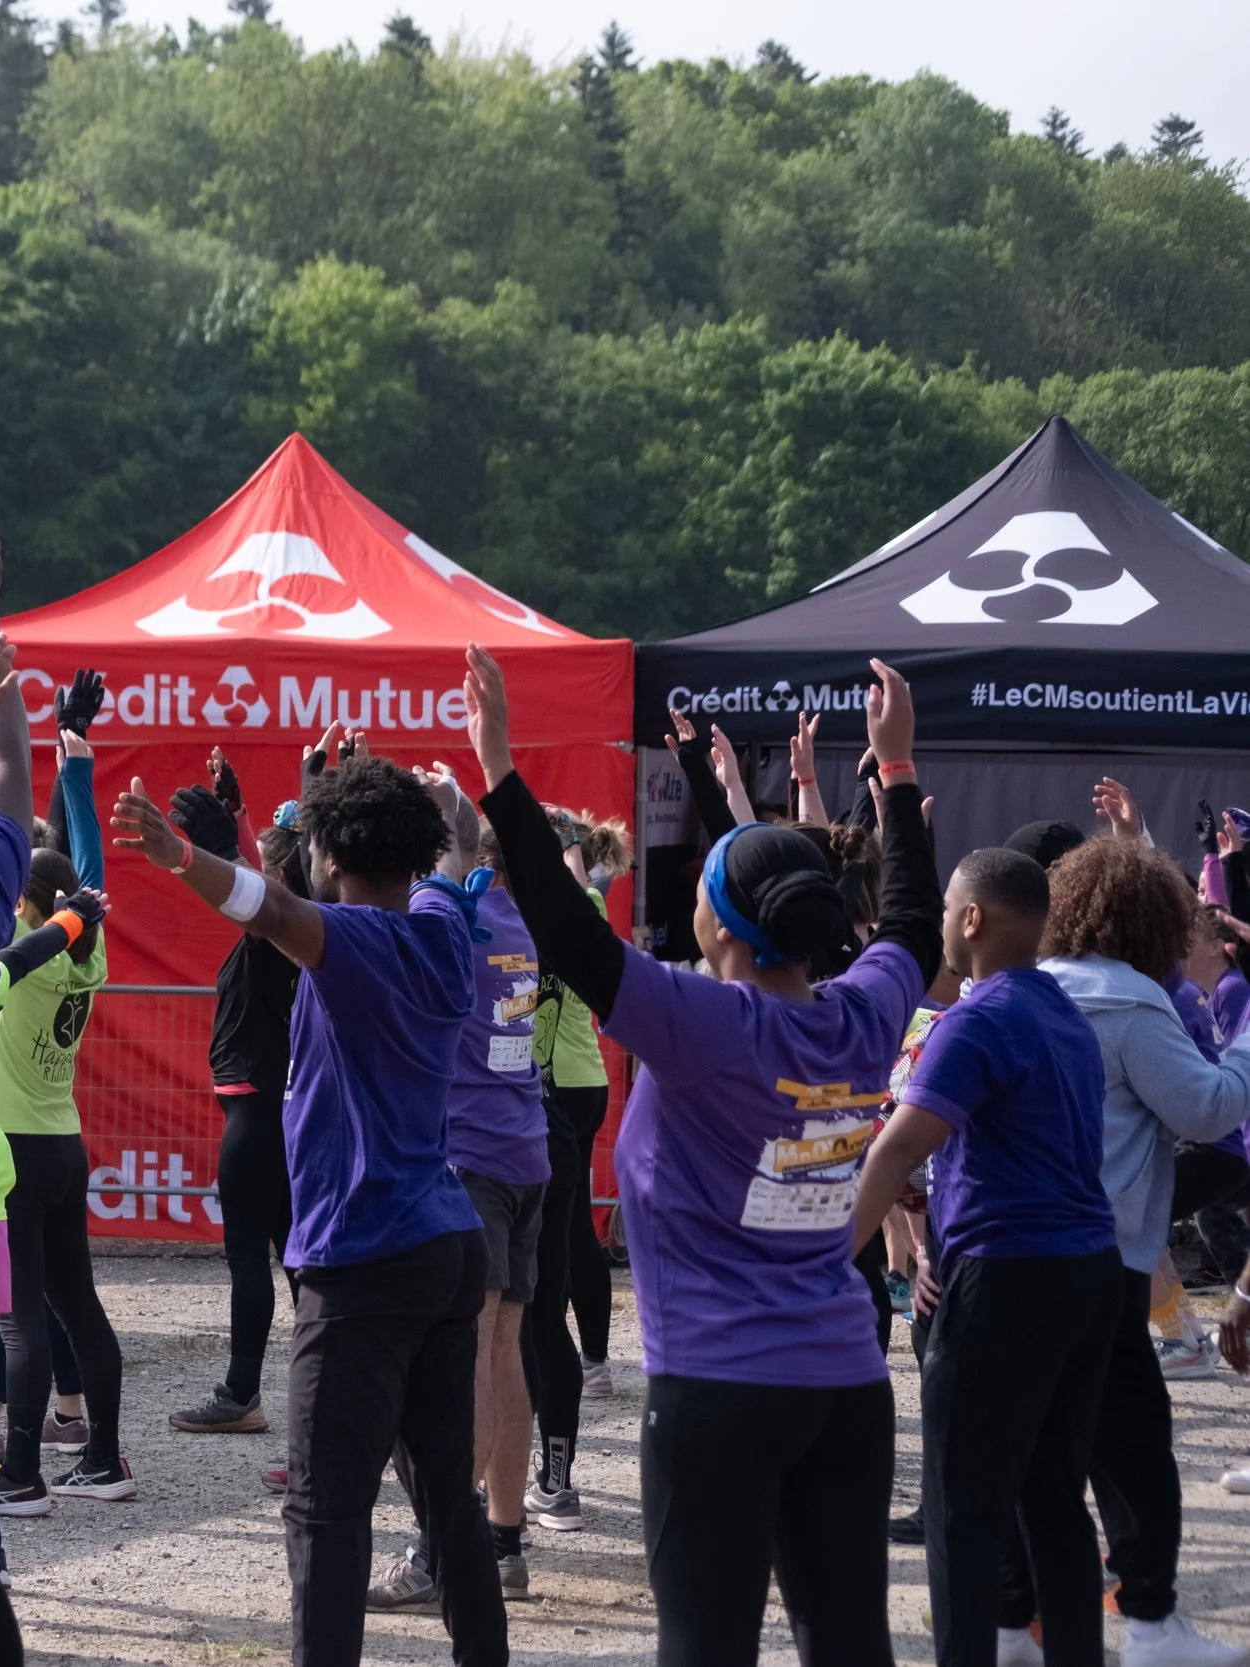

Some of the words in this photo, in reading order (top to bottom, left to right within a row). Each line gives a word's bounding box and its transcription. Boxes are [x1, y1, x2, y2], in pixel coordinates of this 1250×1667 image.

[17, 668, 196, 726] Cédit
[279, 676, 469, 729] Mutue
[667, 686, 762, 714] Crédit
[971, 682, 1250, 716] #LeCMsoutientLaVi
[86, 1150, 192, 1223] dit
